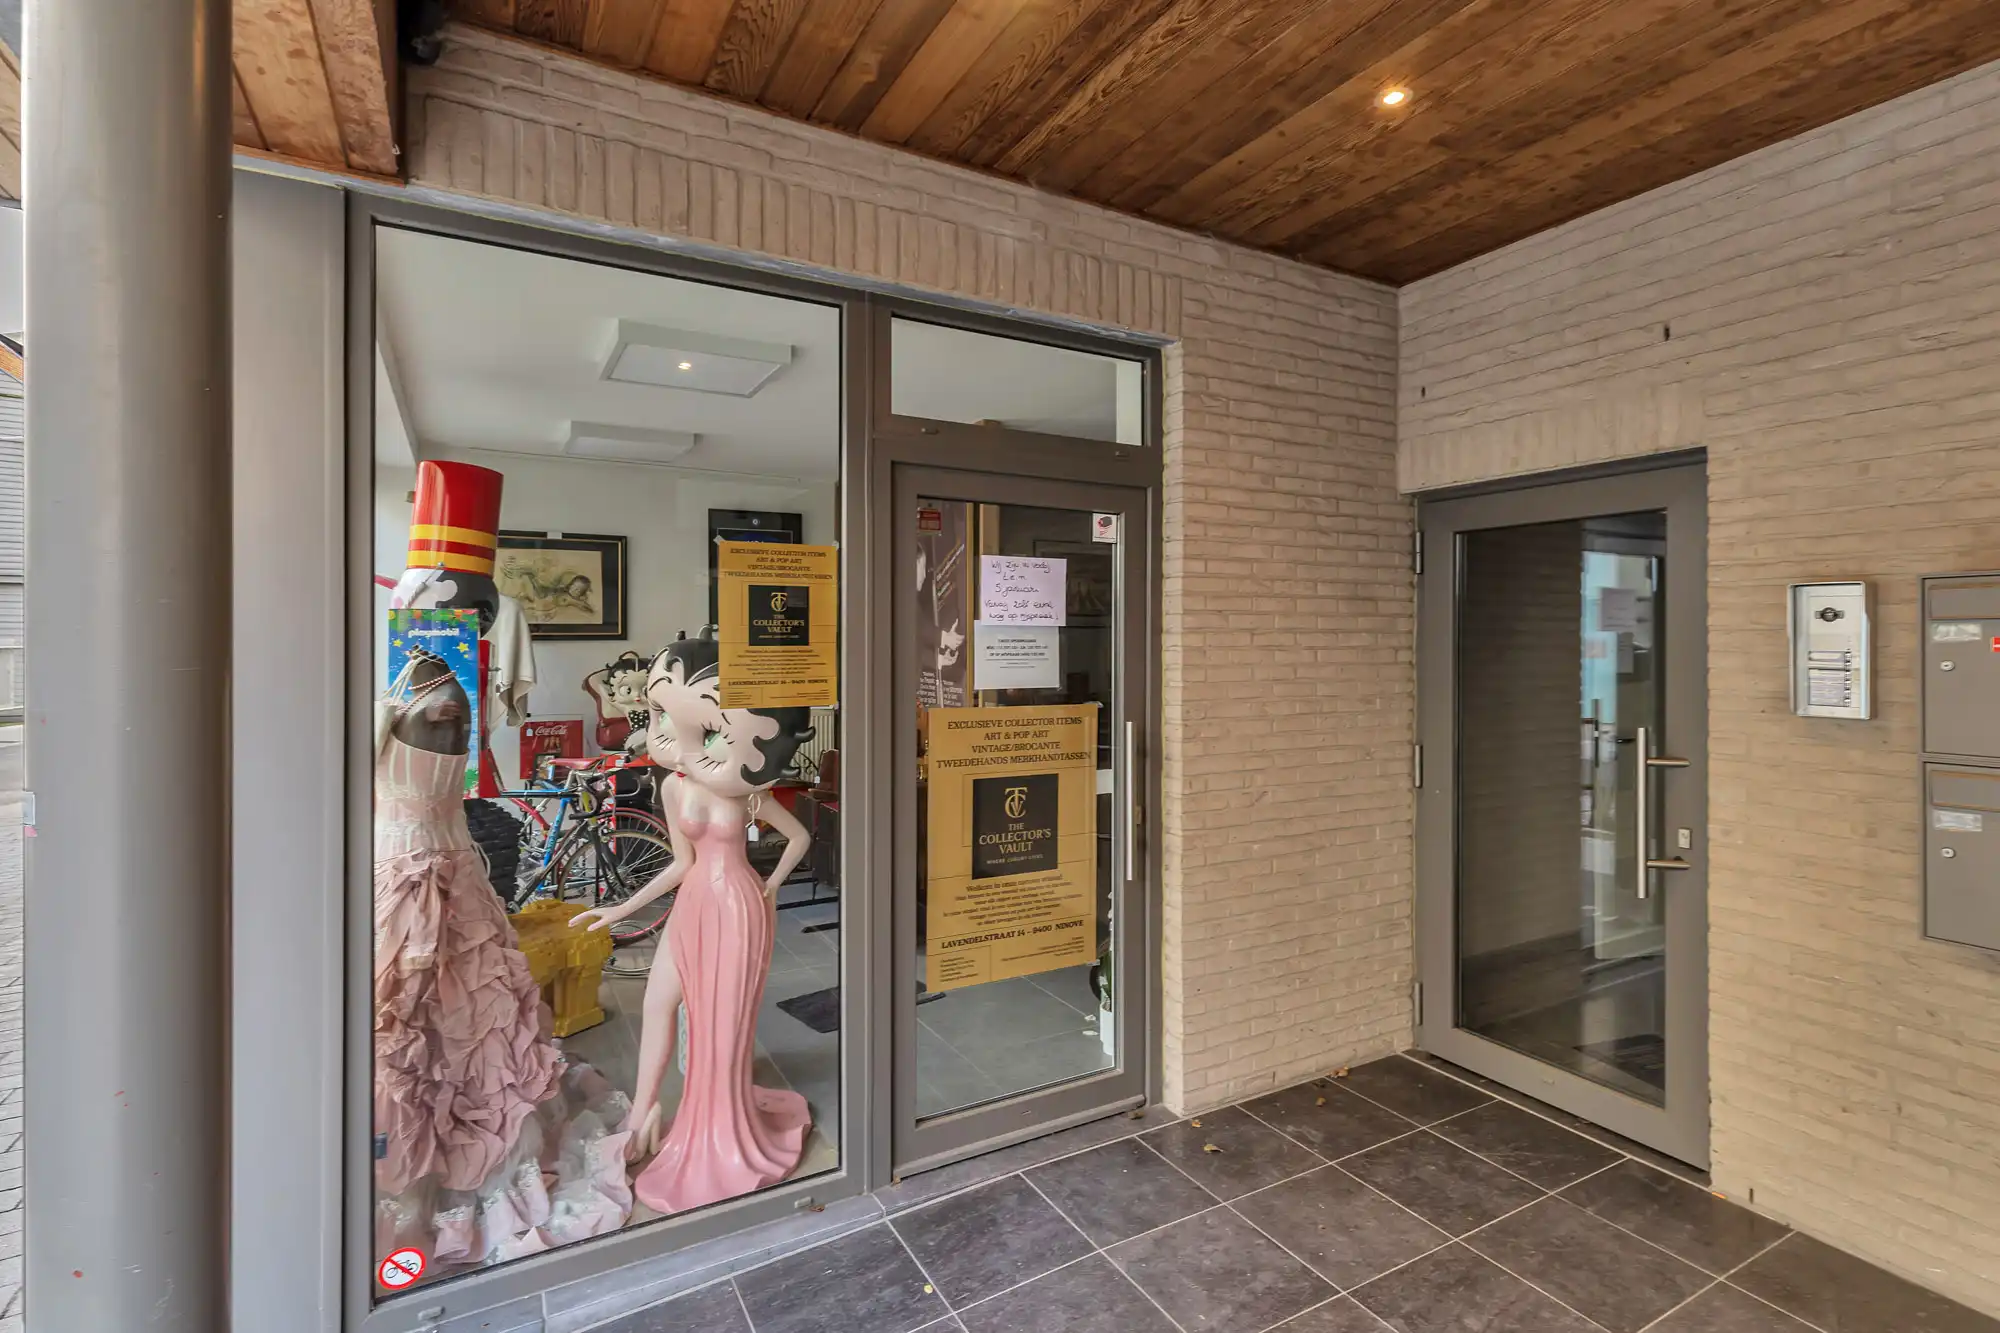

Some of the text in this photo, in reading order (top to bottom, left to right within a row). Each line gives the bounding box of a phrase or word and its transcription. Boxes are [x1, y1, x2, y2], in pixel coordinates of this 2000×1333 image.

[752, 619, 805, 627] COLLECTOR'S
[948, 716, 1083, 729] EXCLUSIEVE COLLECTOR ITEMS
[534, 725, 569, 736] Coca-Cola
[983, 729, 1049, 741] ART & POP ART
[971, 741, 1061, 754] VINTAGE/BROCANTE
[936, 751, 1093, 769] TWEEDEHANDS MERKHANDTASSEN
[1008, 822, 1025, 831] THE
[978, 828, 1052, 845] COLLECTOR'S
[999, 841, 1034, 854] VAULT
[941, 930, 1017, 949] LAVENDELSTRAAT
[1017, 929, 1026, 937] 14
[1032, 925, 1053, 935] 9400
[1055, 919, 1085, 931] NINOVE
